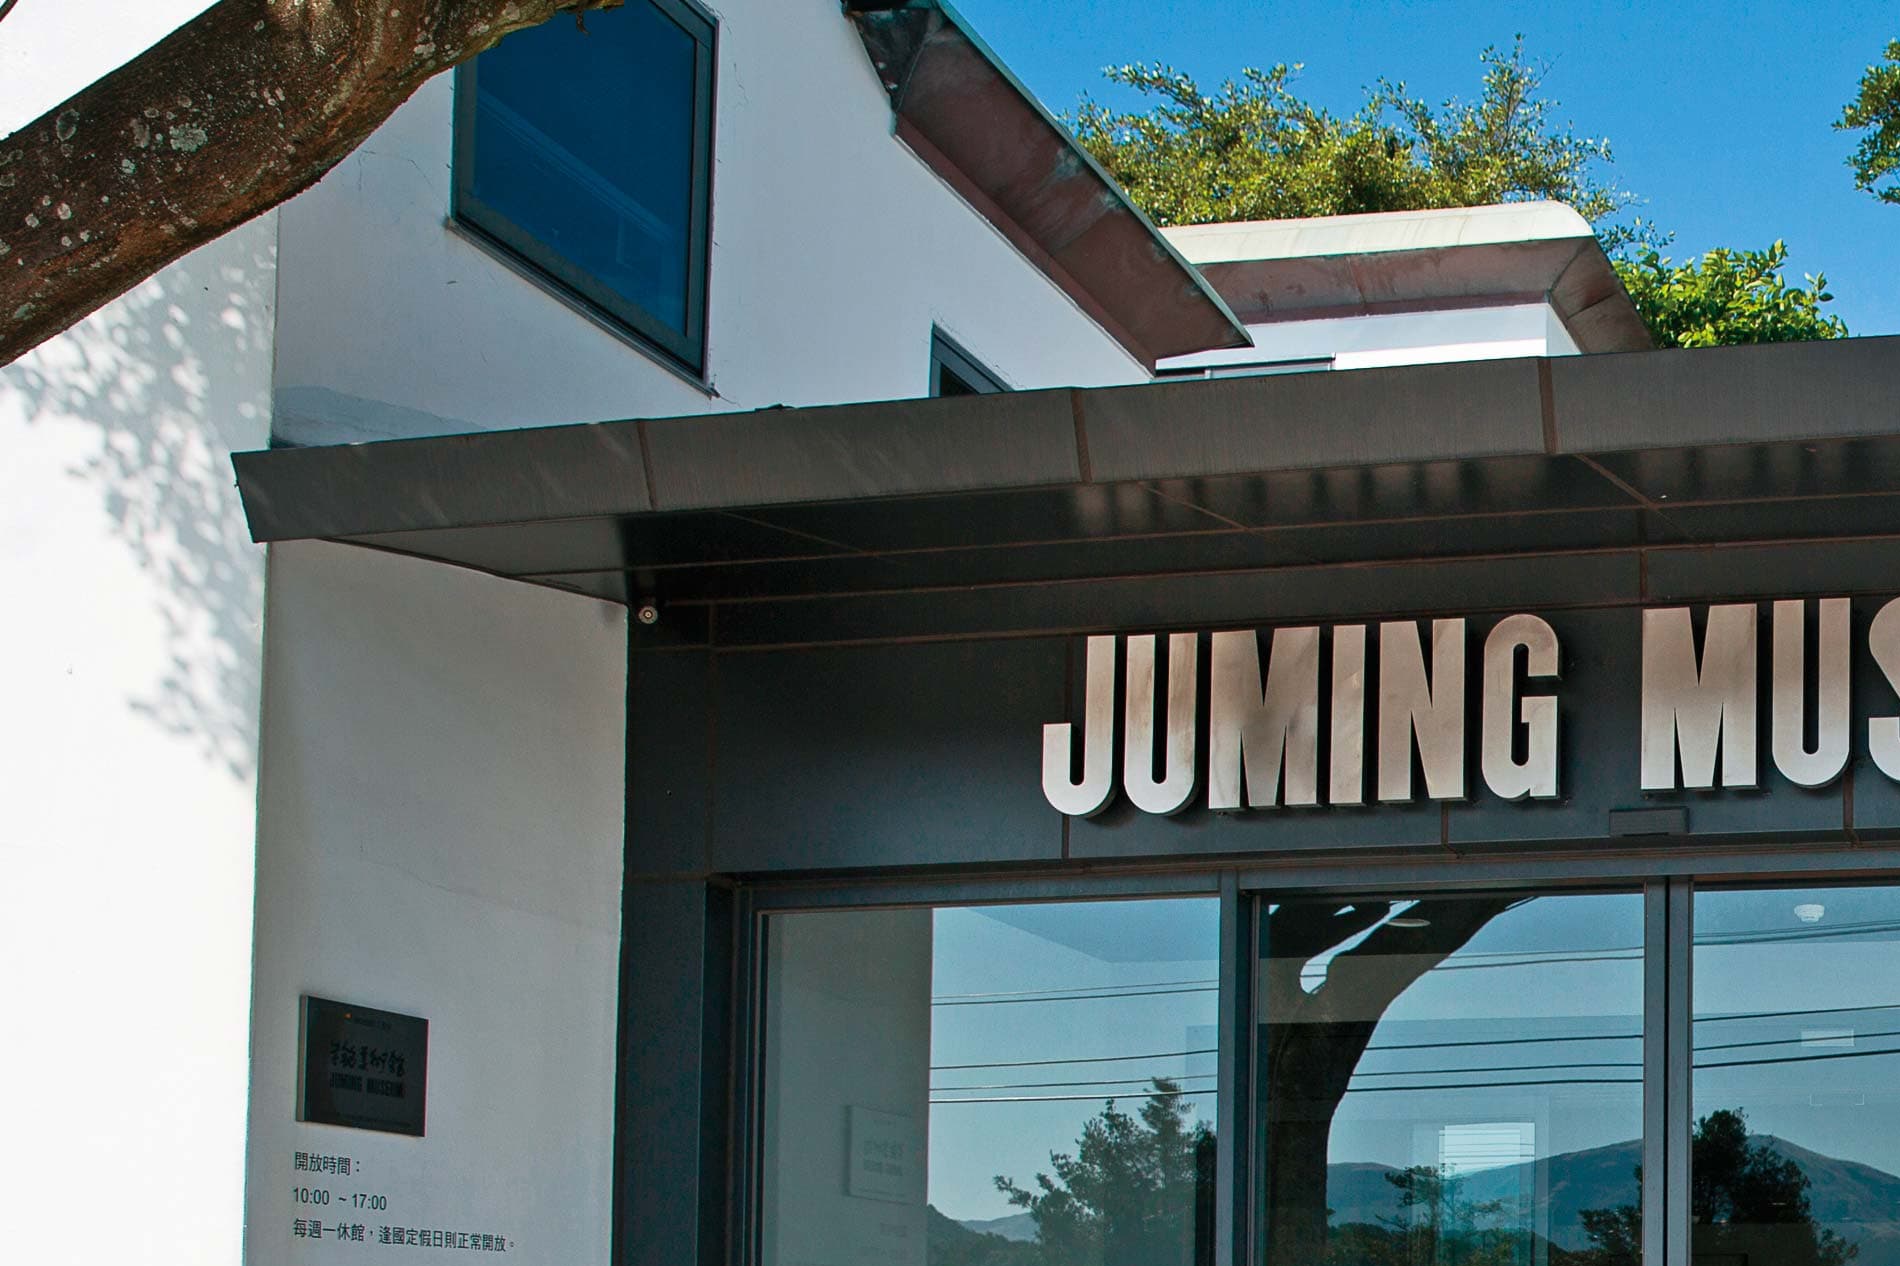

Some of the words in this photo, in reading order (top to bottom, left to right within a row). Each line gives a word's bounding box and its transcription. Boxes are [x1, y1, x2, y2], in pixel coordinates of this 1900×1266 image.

[1042, 612, 1562, 818] JUMING
[293, 1187, 330, 1206] 10:00
[352, 1193, 388, 1211] 17:00
